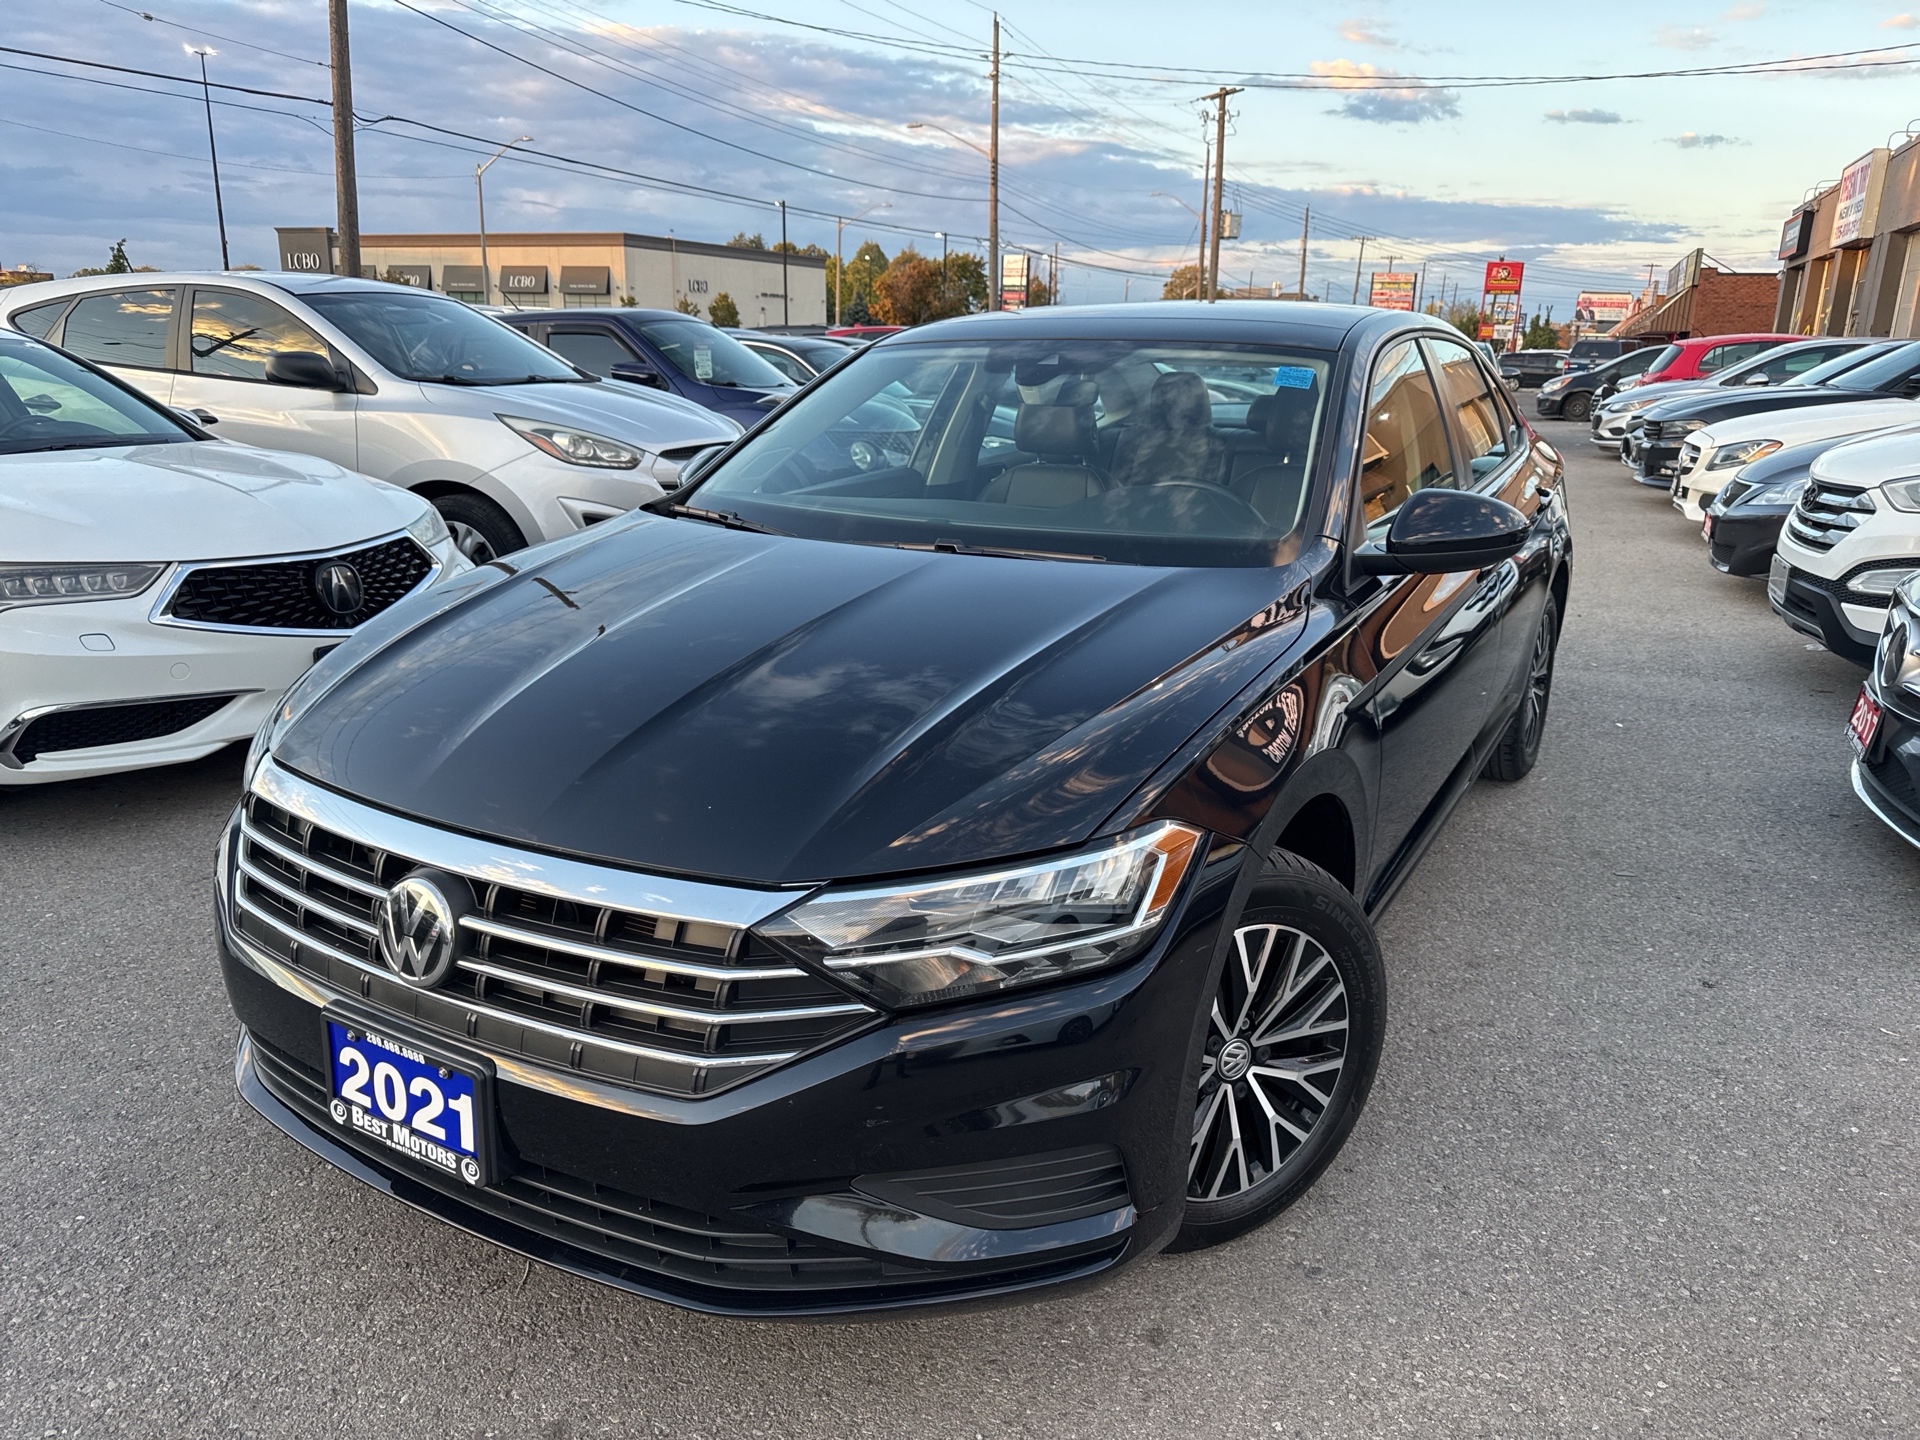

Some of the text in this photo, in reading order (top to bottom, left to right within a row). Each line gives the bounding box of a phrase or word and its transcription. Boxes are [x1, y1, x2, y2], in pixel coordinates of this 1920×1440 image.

[287, 252, 320, 270] LCBO
[509, 275, 535, 288] LCBO
[688, 279, 708, 294] LCBO
[339, 1046, 475, 1153] 2021
[352, 1105, 388, 1138] BEST
[393, 1123, 458, 1170] MOTORS
[386, 1138, 422, 1161] Hamilton
